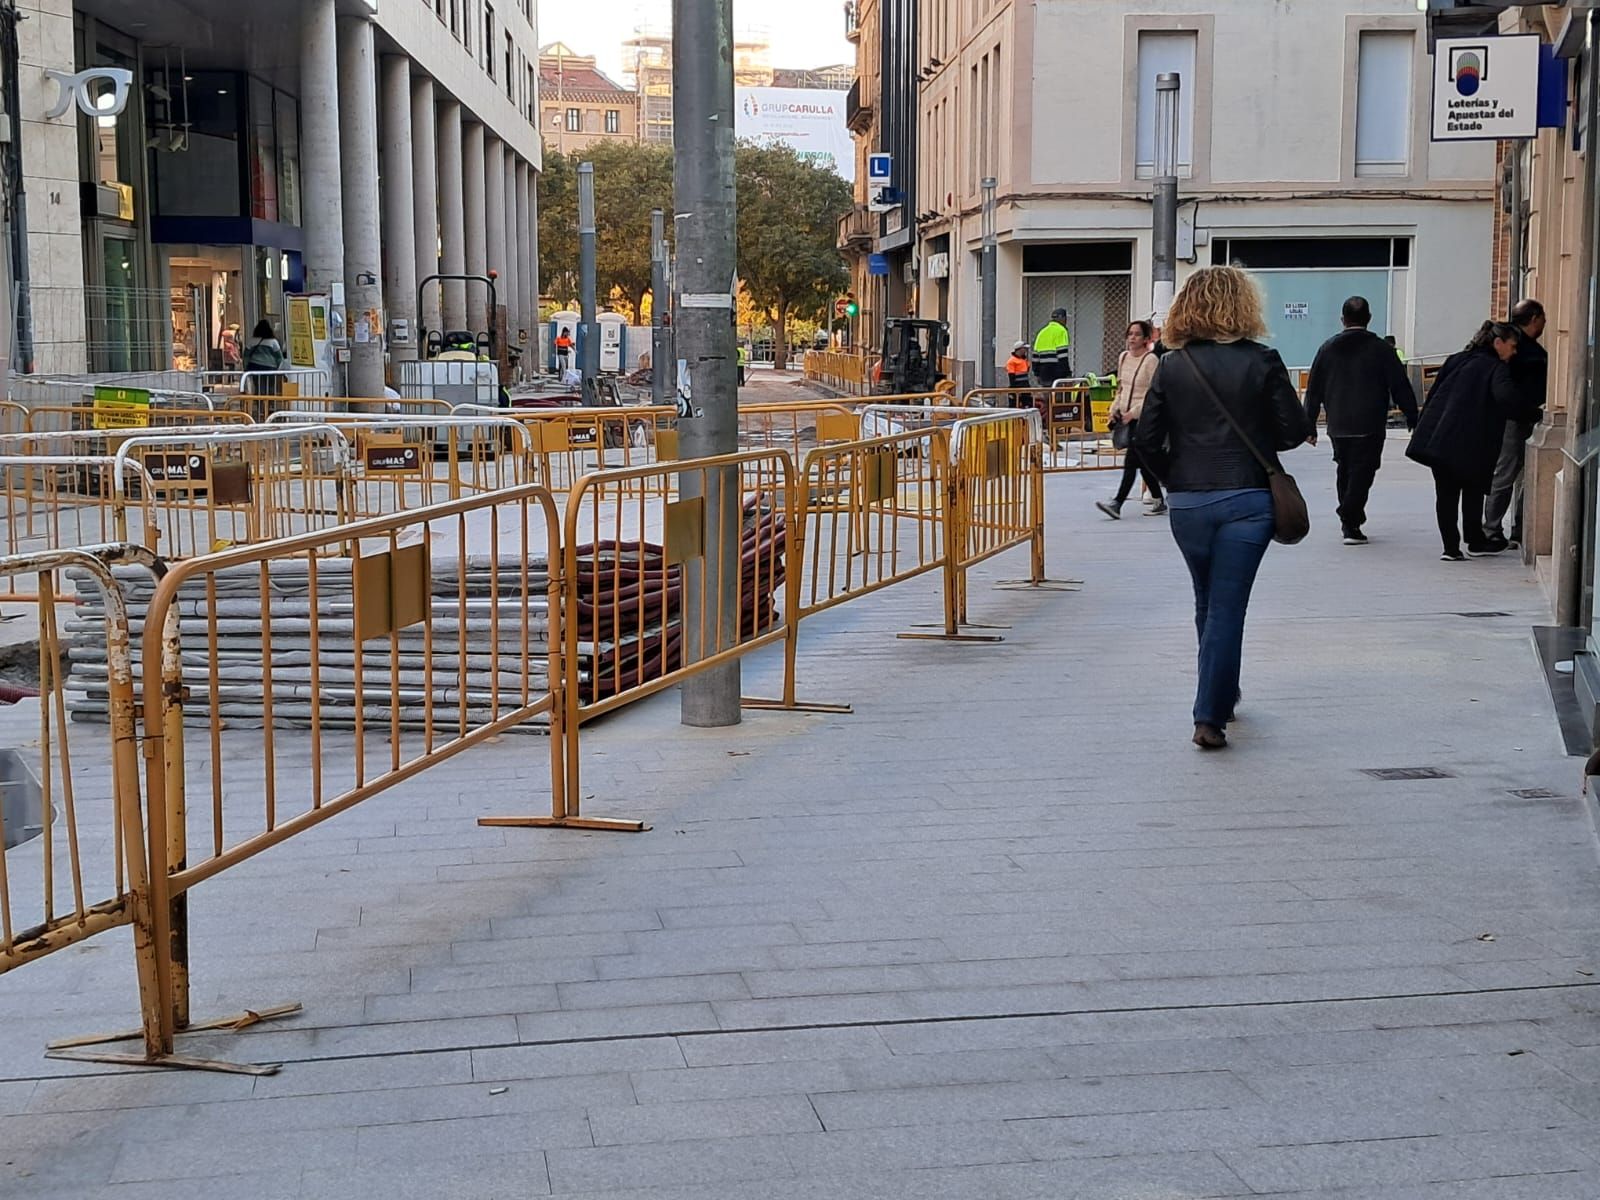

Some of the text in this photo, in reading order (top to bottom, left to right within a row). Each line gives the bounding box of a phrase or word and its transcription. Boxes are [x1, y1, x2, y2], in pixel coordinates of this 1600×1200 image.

[761, 103, 834, 114] GRUPCARULLA
[1448, 98, 1498, 109] Loterías y
[1448, 109, 1514, 121] Apuestas del
[1447, 121, 1483, 132] Estado
[874, 159, 885, 175] L
[49, 191, 61, 205] 14
